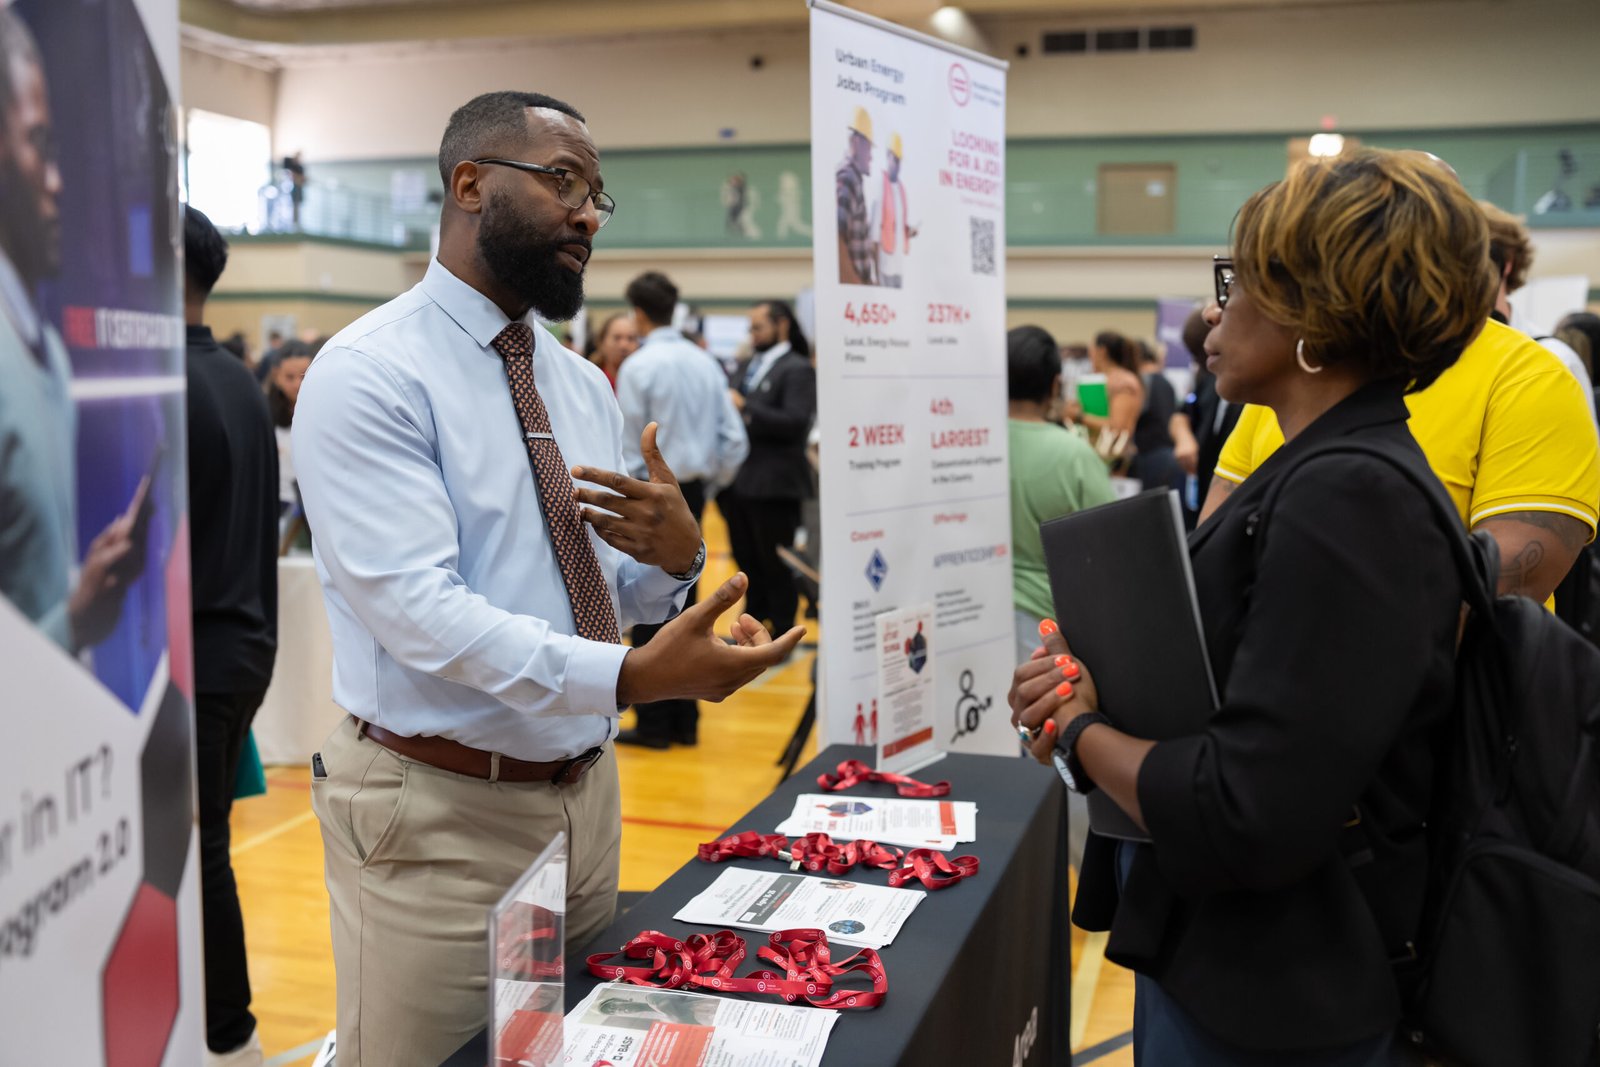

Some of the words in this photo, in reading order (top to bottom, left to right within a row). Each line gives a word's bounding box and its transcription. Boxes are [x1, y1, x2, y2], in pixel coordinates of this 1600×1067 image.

[835, 48, 868, 70] Urban
[871, 59, 904, 84] Energy
[837, 75, 861, 93] Jobs
[864, 81, 907, 105] Program
[844, 303, 896, 326] 4,650+
[931, 398, 953, 415] 4th
[849, 426, 859, 448] 2
[863, 425, 904, 446] WEEK
[931, 428, 989, 449] LARGEST
